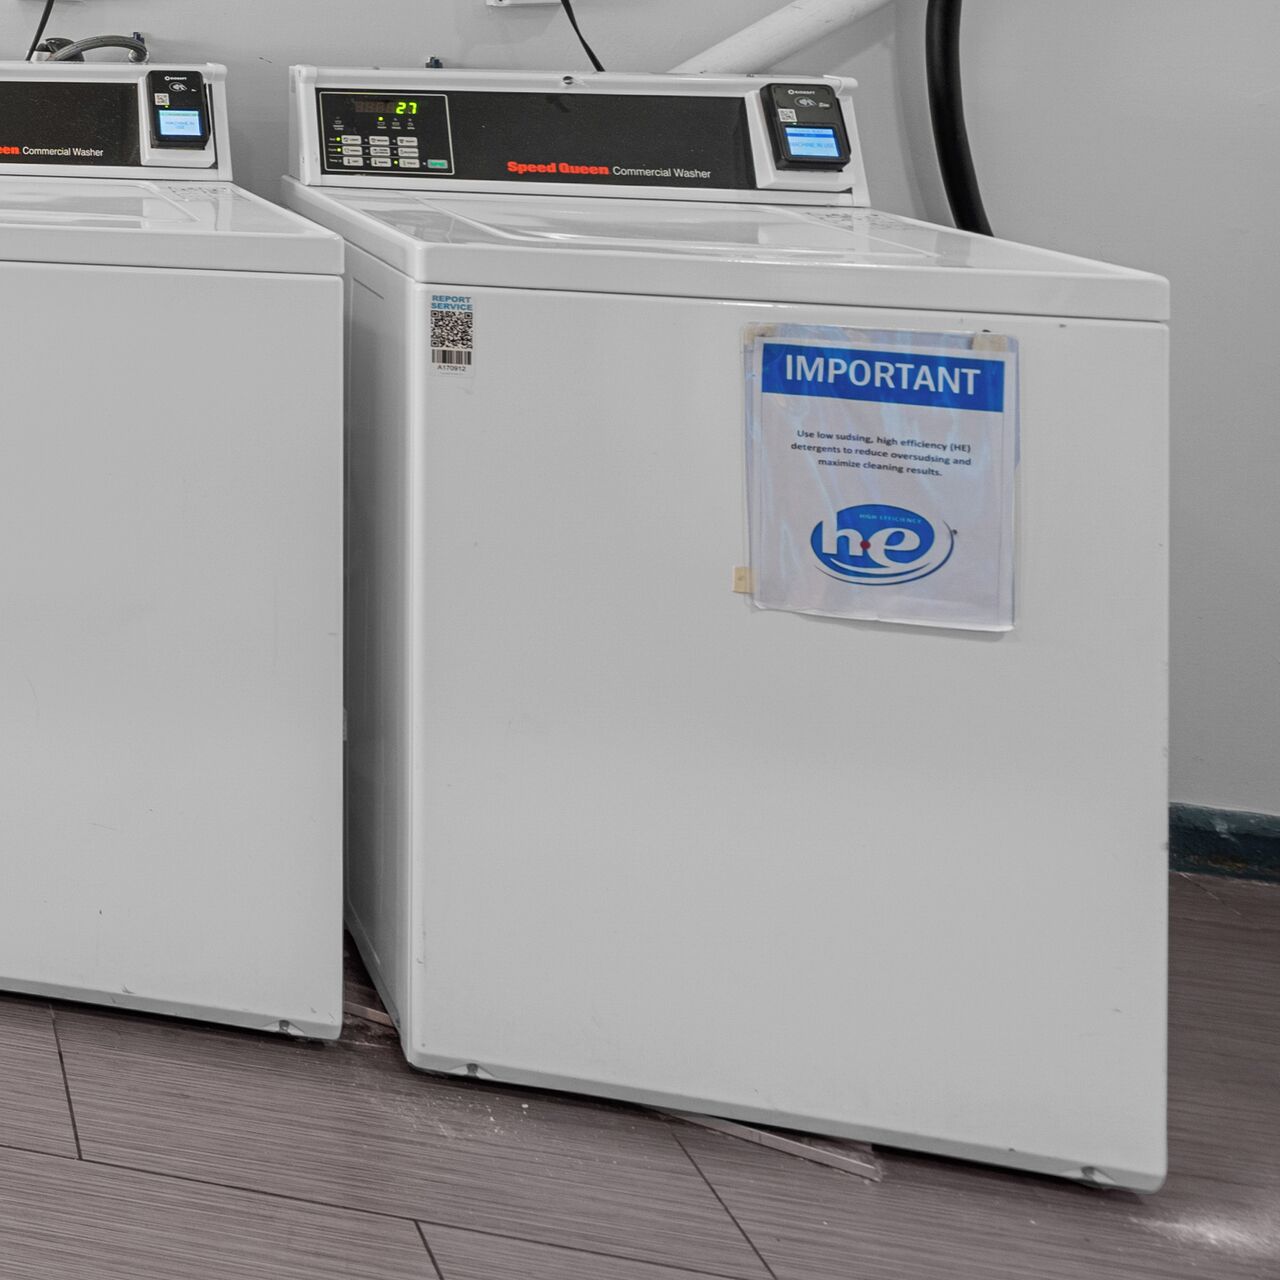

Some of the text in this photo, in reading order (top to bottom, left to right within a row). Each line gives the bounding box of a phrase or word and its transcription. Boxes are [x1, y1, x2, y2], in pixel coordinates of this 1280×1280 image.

[396, 102, 417, 114] 27
[22, 147, 71, 156] Commercial
[72, 148, 103, 156] Washer
[507, 161, 711, 178] Speed Queen Commercial Washer
[432, 295, 471, 303] REPORT
[786, 354, 981, 396] IMPORTANT
[877, 436, 897, 446] high
[900, 440, 946, 451] efficiency
[791, 443, 841, 453] detergents
[855, 448, 888, 456] reduce
[891, 452, 950, 465] oversudsing
[818, 459, 943, 476] maximize cleaning results.
[822, 513, 921, 568] he
